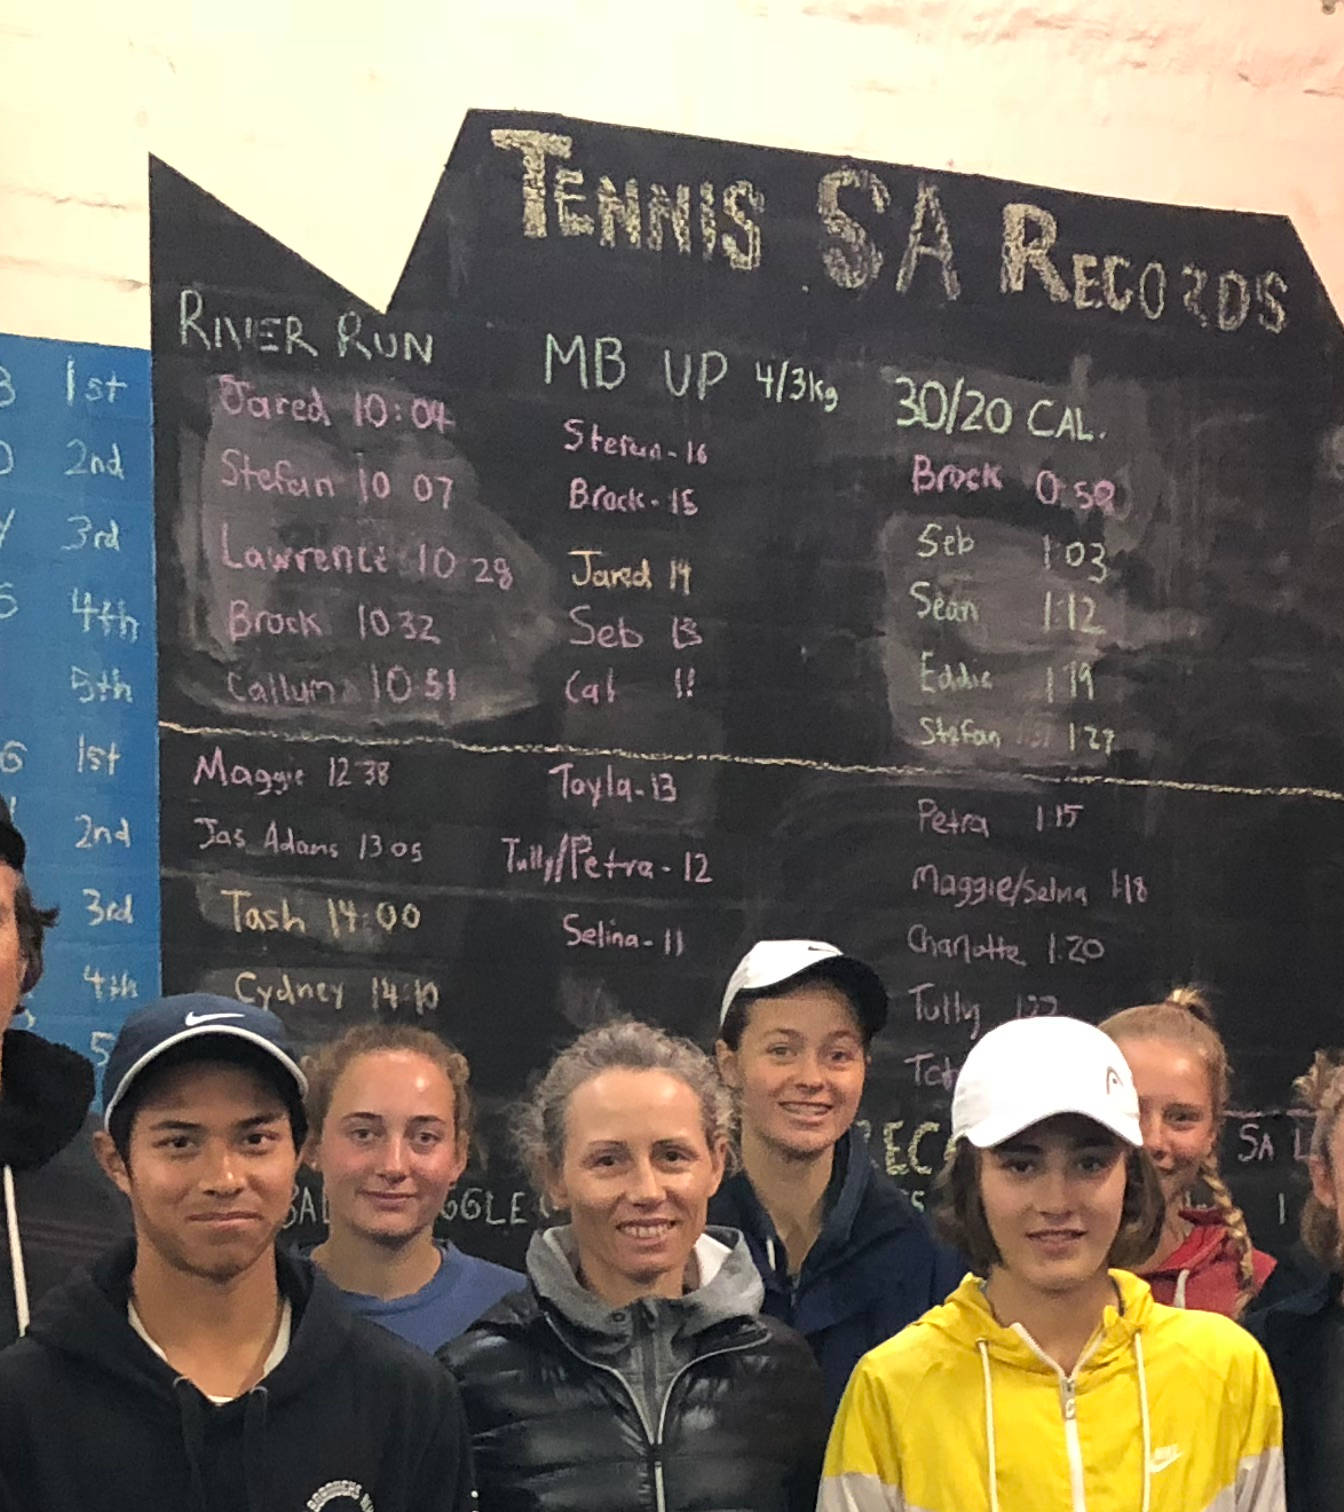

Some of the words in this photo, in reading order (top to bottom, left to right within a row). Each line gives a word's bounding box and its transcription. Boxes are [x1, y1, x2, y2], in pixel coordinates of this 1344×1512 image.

[491, 128, 765, 271] TENNIS
[818, 164, 960, 302] SA
[180, 289, 318, 358] RIVER
[337, 310, 434, 365] RUN
[66, 355, 128, 407] 1st
[544, 332, 626, 390] MB
[664, 350, 728, 400] UP
[895, 375, 1013, 435] 30/20
[64, 438, 125, 481] 2nd
[61, 515, 120, 551] 3rd
[916, 522, 976, 559] Seb
[567, 549, 653, 591] Jared
[72, 587, 141, 645] 4th
[228, 599, 324, 643] Brock
[568, 605, 645, 650] Seb
[71, 665, 135, 704] 5th
[76, 734, 122, 777] 1st
[73, 813, 132, 850] 2nd
[917, 797, 990, 838] Petra
[263, 820, 339, 859] Adams
[82, 888, 134, 927] 3rd
[220, 889, 307, 934] Tash
[907, 981, 982, 1042] Tully
